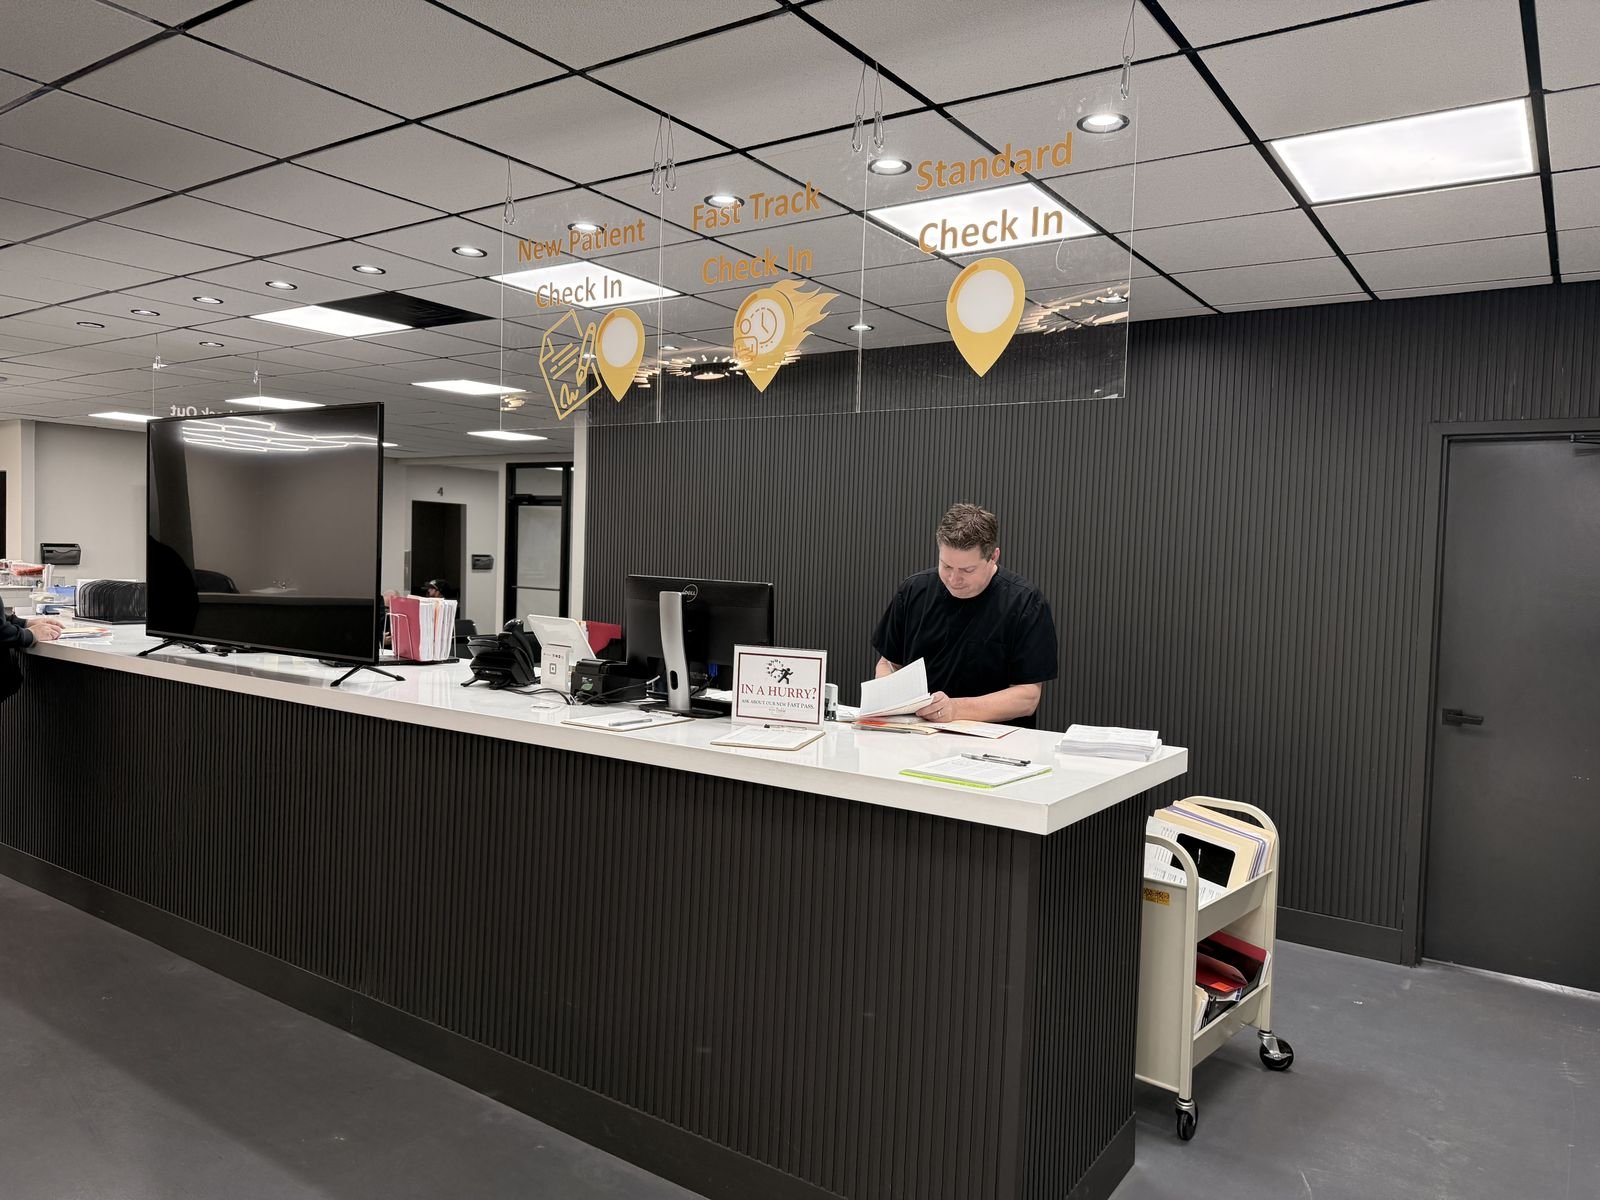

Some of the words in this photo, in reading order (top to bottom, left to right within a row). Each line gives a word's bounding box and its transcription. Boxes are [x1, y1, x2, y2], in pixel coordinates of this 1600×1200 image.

[916, 131, 1073, 192] Standard
[692, 200, 741, 231] Fast
[750, 181, 821, 221] Track
[518, 238, 563, 263] New
[568, 218, 646, 254] Patient
[918, 208, 1018, 253] Check
[1031, 206, 1063, 237] In
[702, 247, 779, 286] Check
[787, 245, 813, 273] In
[536, 276, 597, 308] Check
[603, 275, 623, 299] In
[437, 487, 443, 496] 4
[741, 683, 754, 694] IN
[756, 686, 765, 695] A
[768, 685, 817, 700] HURRY?
